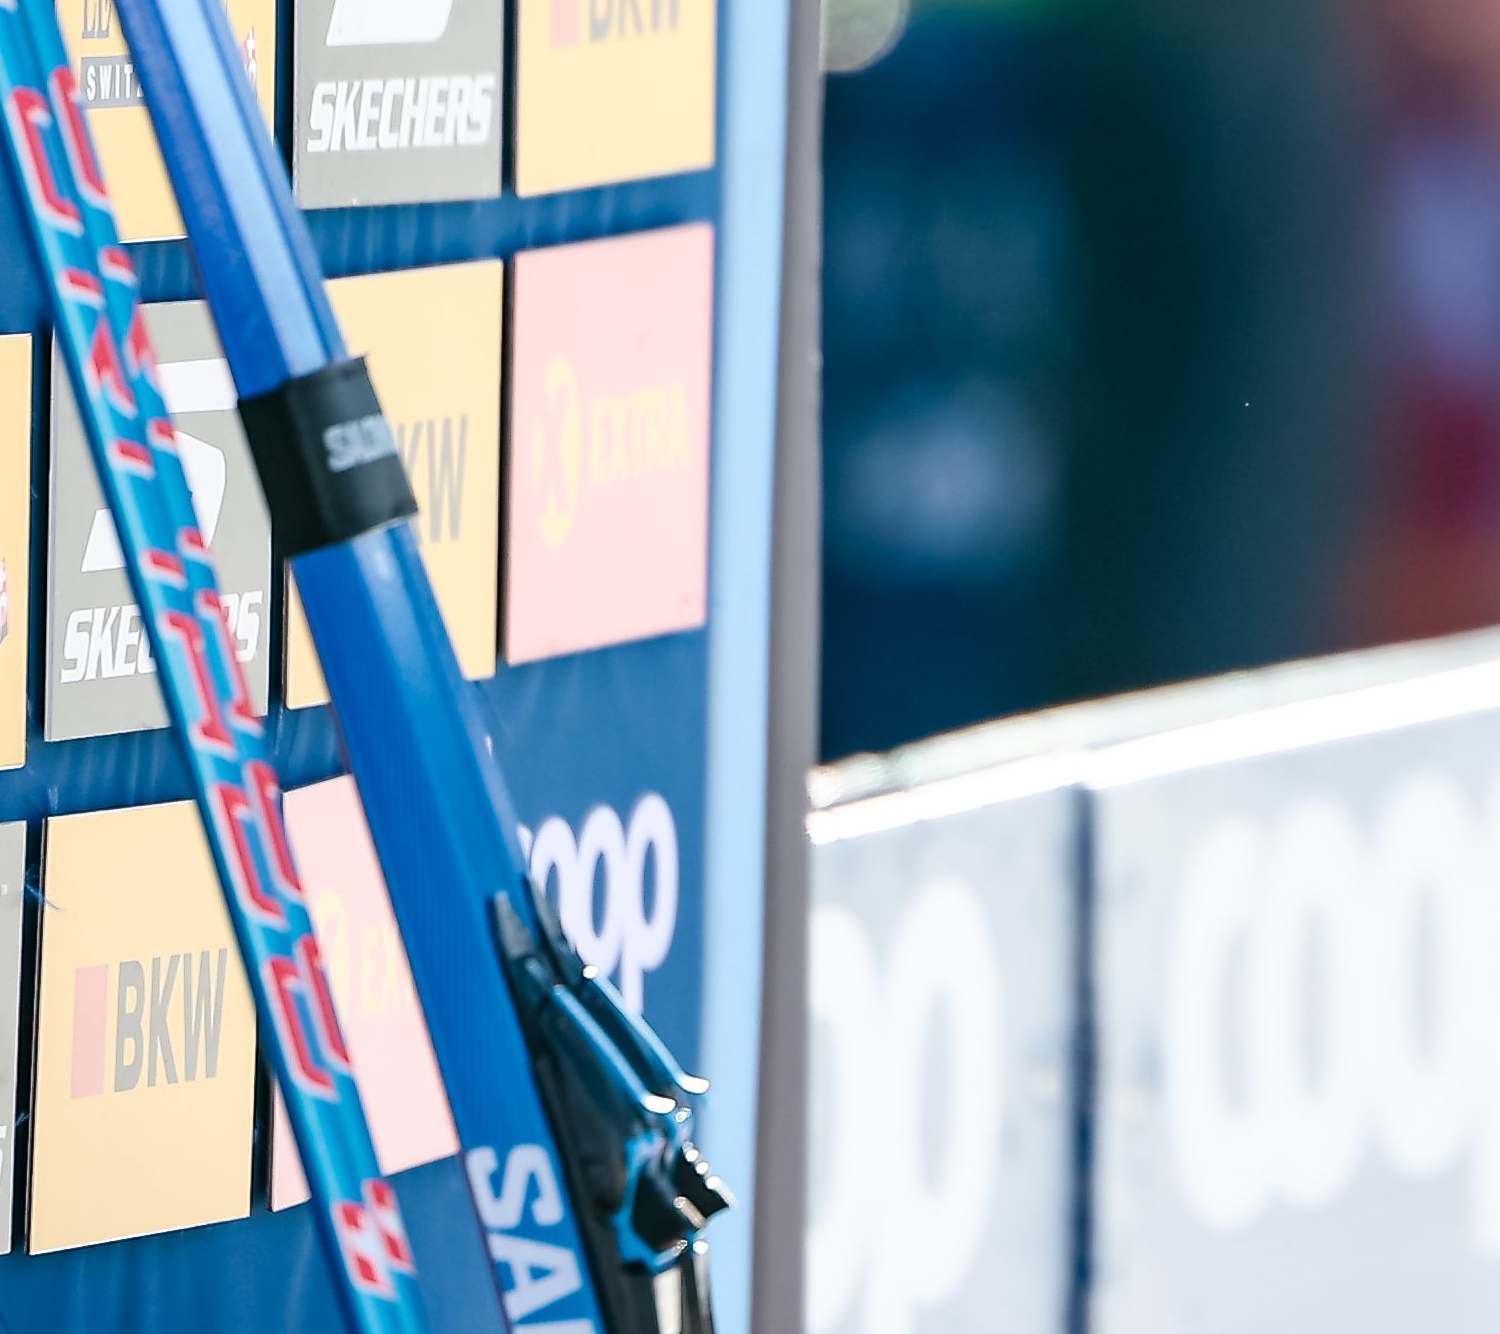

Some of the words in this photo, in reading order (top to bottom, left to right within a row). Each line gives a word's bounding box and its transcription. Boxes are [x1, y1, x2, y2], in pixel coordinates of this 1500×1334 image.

[306, 74, 495, 154] SKECHERS
[516, 791, 679, 1012] oop
[113, 948, 228, 1092] BKW
